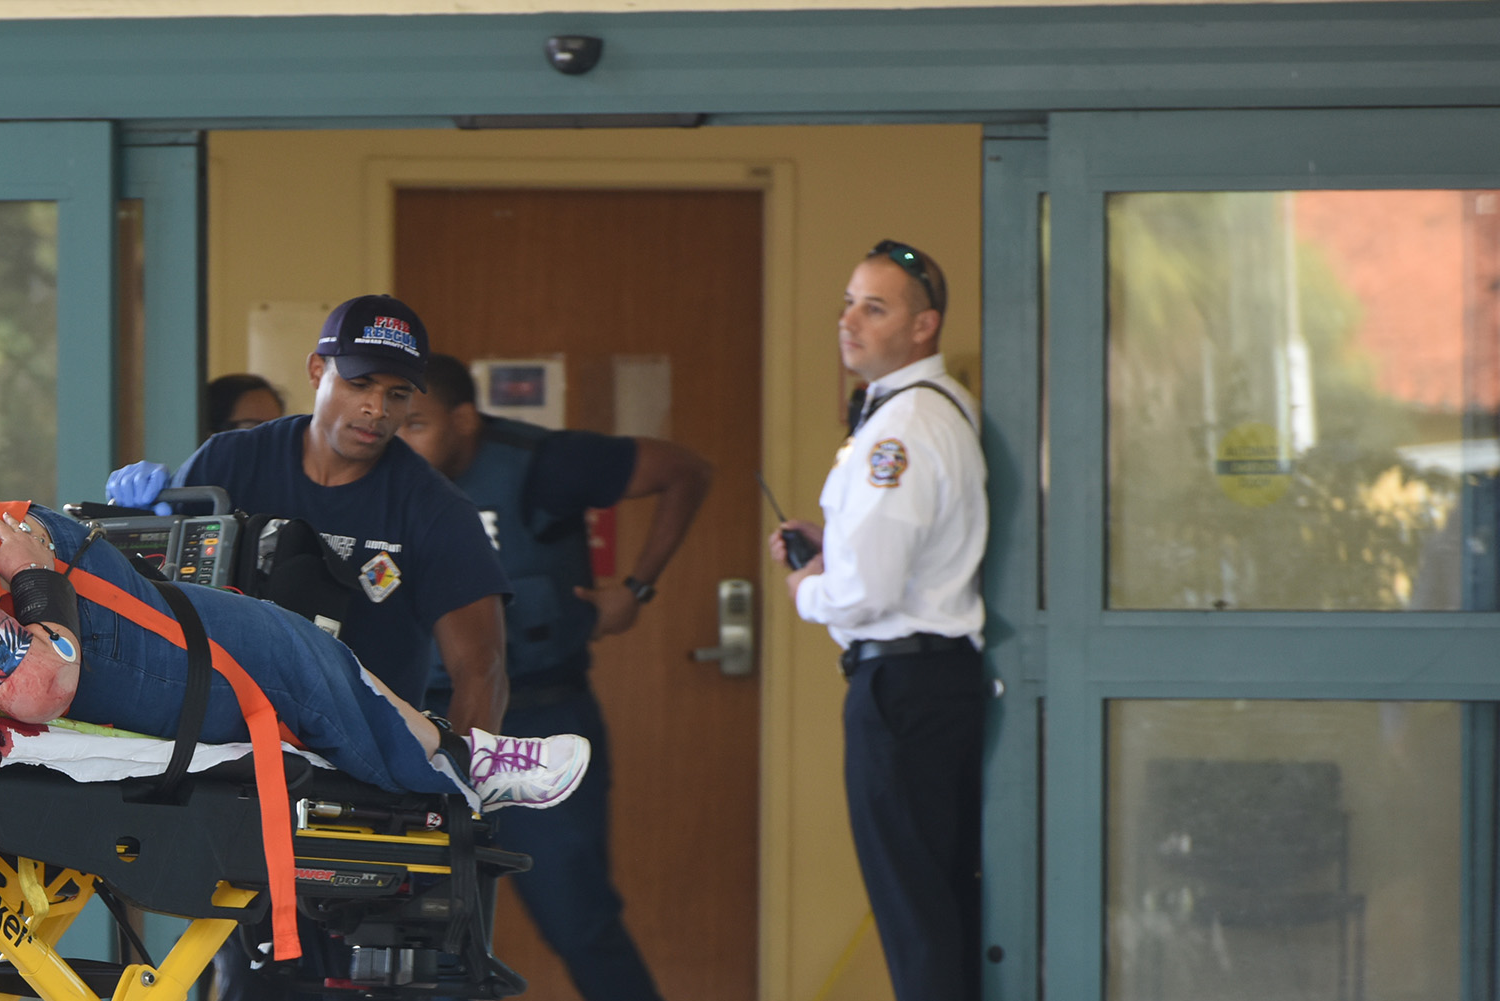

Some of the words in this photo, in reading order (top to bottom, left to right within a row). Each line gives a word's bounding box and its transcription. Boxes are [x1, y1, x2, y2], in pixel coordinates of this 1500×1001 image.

[374, 315, 411, 334] FIRE
[362, 326, 418, 350] RESCUE
[295, 867, 336, 881] ower
